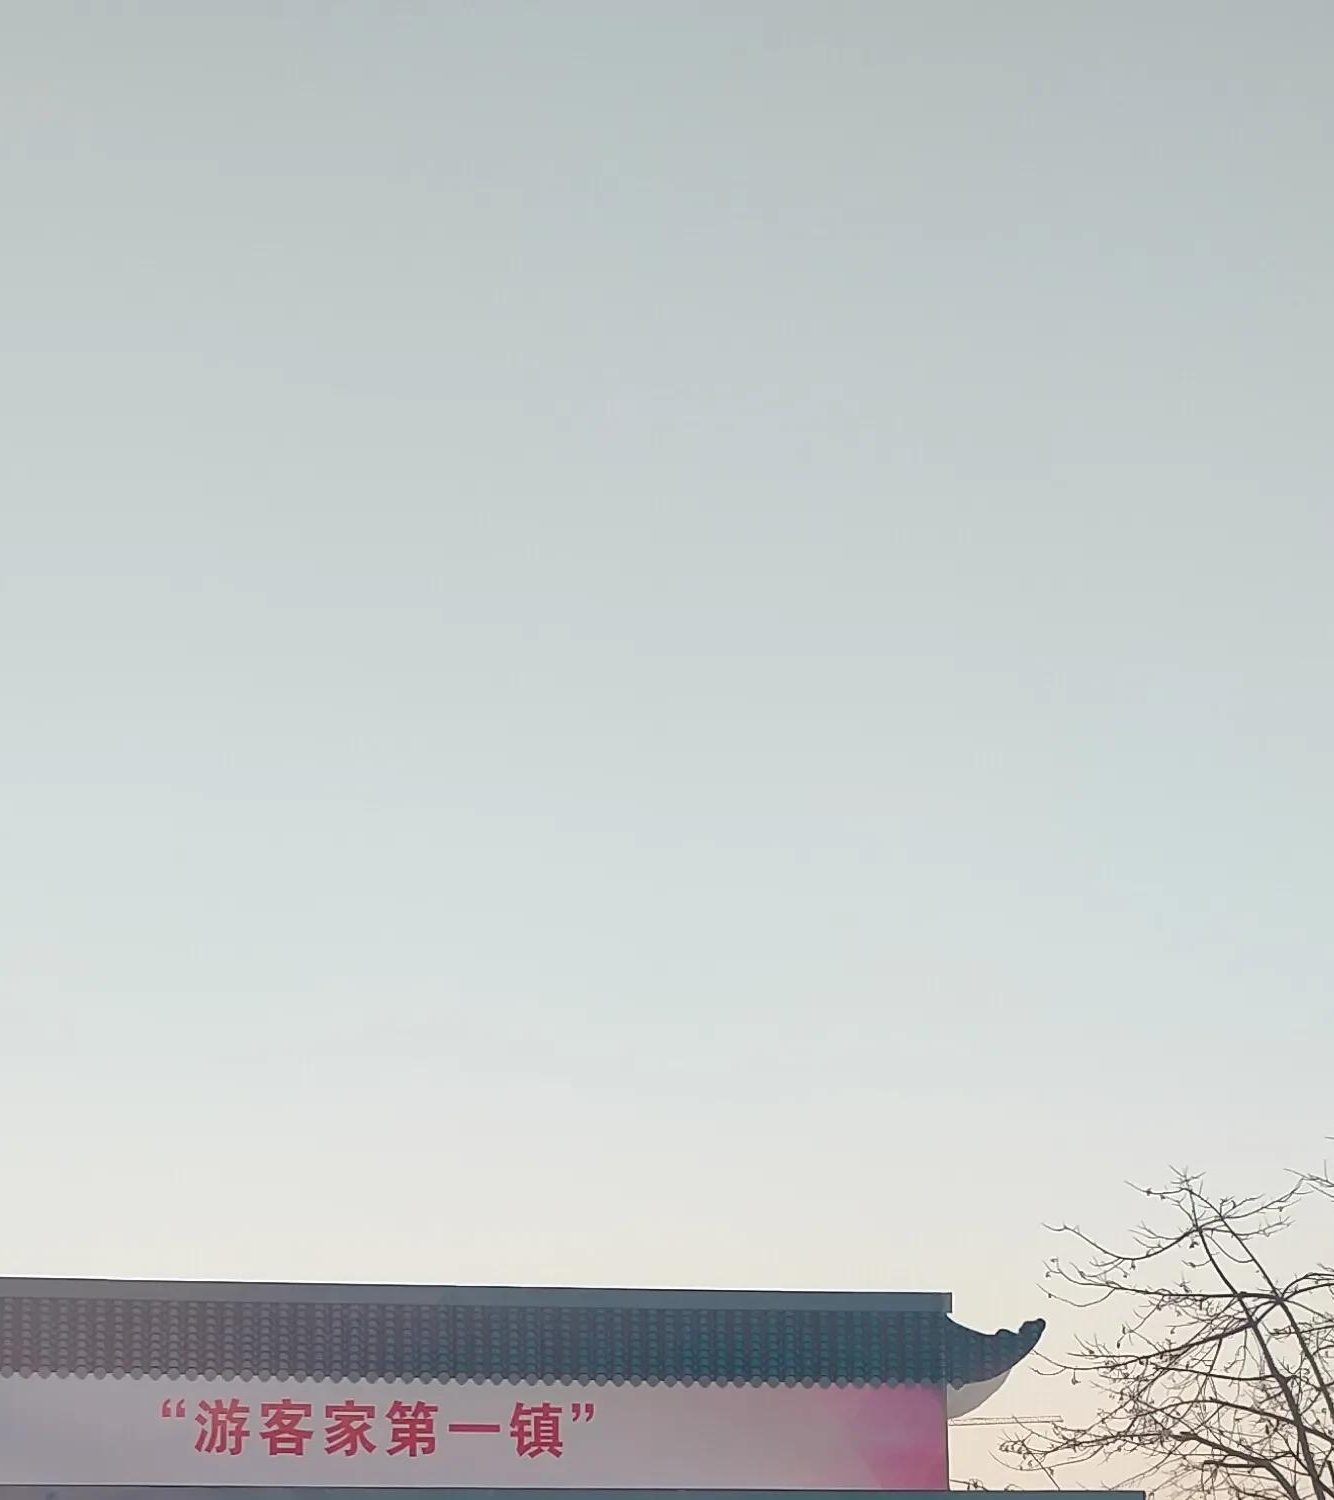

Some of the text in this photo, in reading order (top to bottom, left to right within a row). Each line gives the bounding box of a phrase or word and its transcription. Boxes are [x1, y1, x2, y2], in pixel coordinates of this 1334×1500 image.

[160, 1397, 595, 1459] “游客家第一镇”
